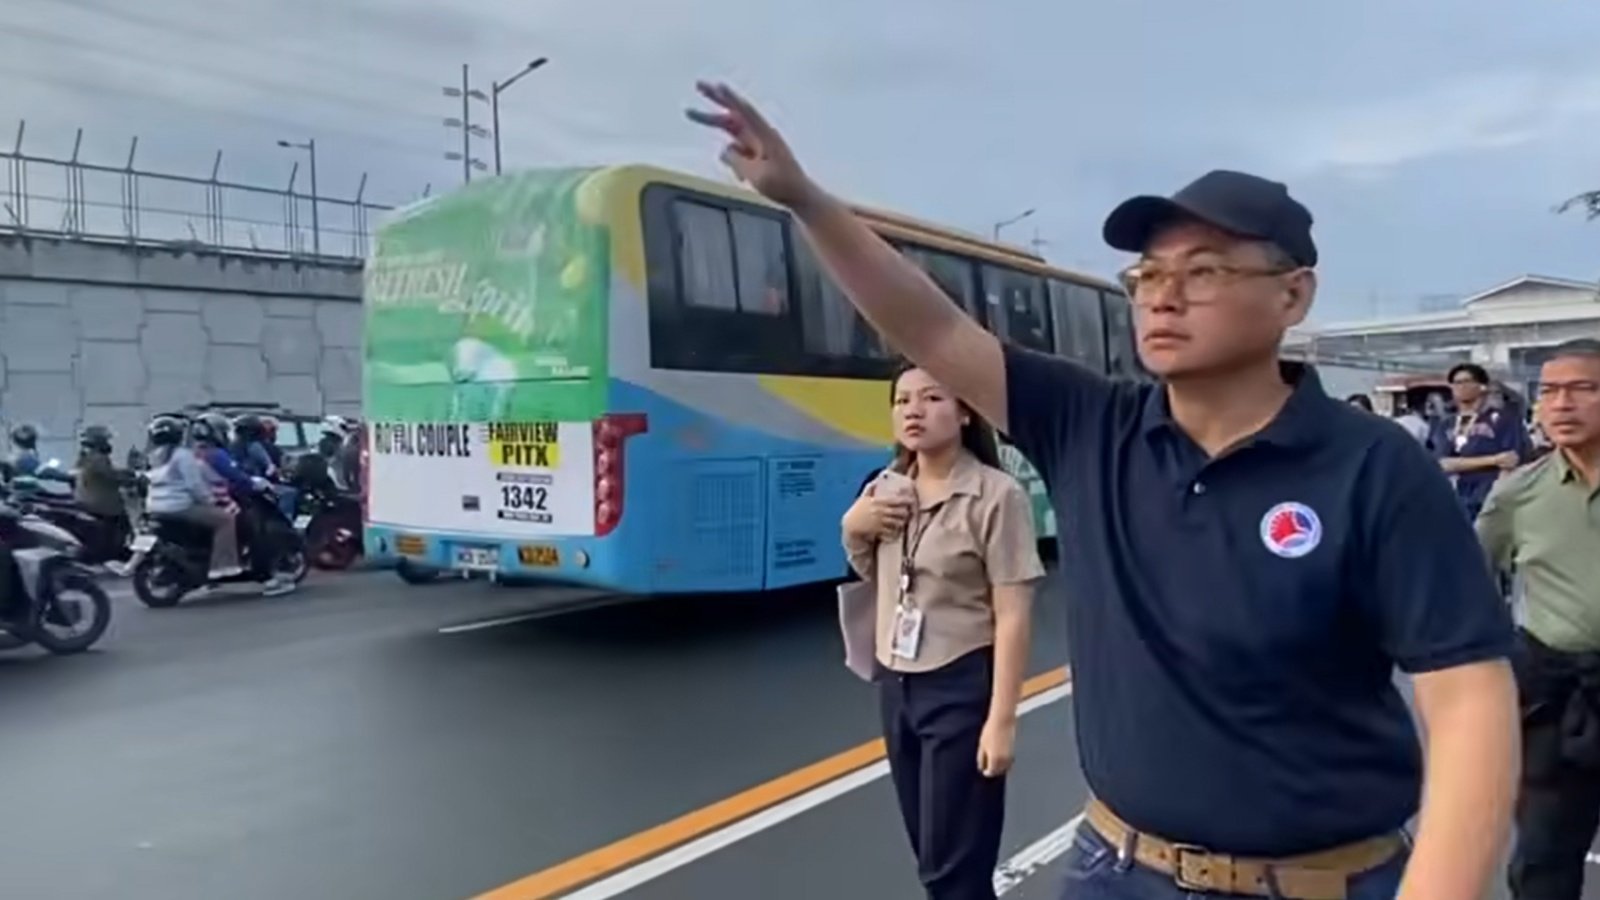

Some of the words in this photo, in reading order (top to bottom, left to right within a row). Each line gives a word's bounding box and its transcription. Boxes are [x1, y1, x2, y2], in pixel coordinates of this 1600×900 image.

[376, 423, 414, 455] ROYAL
[417, 424, 470, 457] COUPLE
[488, 421, 558, 443] FAIRVIEW
[503, 444, 548, 466] PITX
[501, 485, 547, 510] 1342
